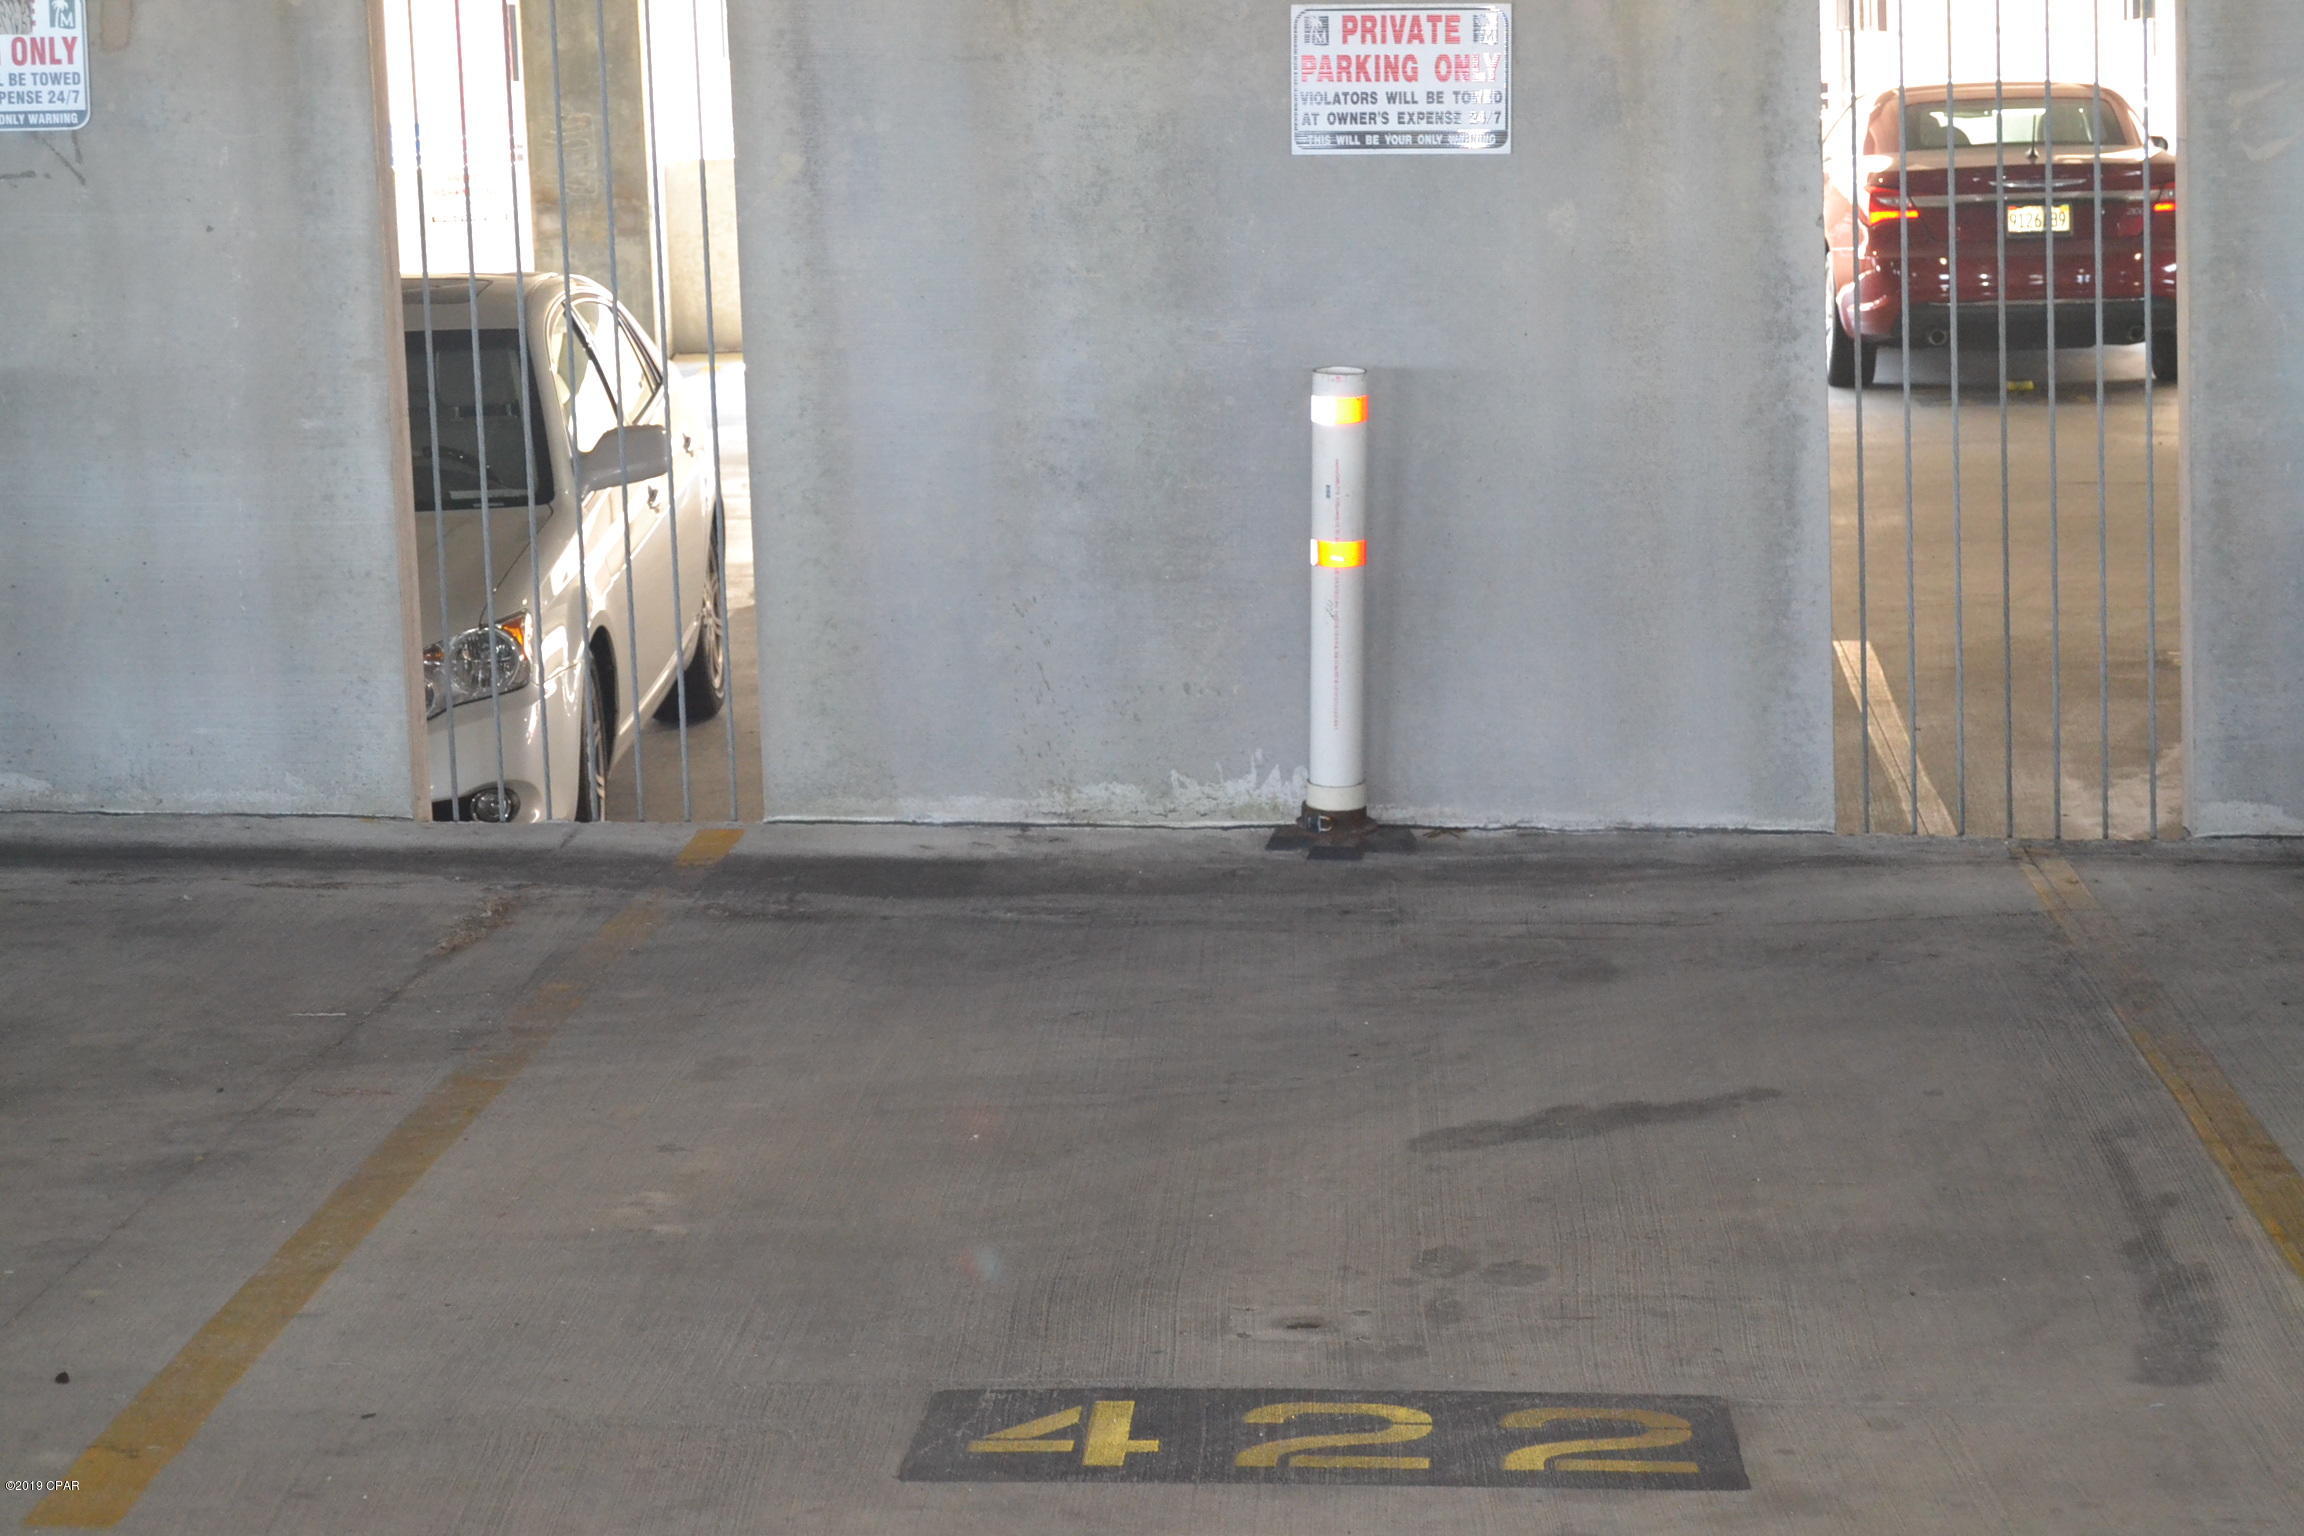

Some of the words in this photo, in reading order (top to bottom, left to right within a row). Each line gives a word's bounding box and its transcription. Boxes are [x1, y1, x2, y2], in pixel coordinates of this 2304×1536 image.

[1341, 15, 1461, 44] PRIVATE
[11, 36, 78, 66] ONLY
[1301, 54, 1418, 82] PARKING
[1434, 54, 1501, 82] ONLY
[8, 73, 26, 86] BE
[30, 72, 81, 86] TOWED
[47, 90, 79, 105] 24/7
[1300, 91, 1378, 105] VIOLATORS
[1386, 91, 1418, 105] WILL
[1426, 90, 1444, 104] BE
[1453, 90, 1503, 104] TOD
[28, 113, 78, 124] WARNING
[1302, 113, 1320, 126] AT
[1327, 111, 1389, 125] OWNER'S
[1397, 110, 1462, 125] EXPENSE
[1336, 134, 1360, 145] WILL
[1365, 134, 1379, 145] BE
[1385, 134, 1412, 145] YOUR
[1417, 134, 1442, 145] ONLY
[966, 1399, 1700, 1473] 422
